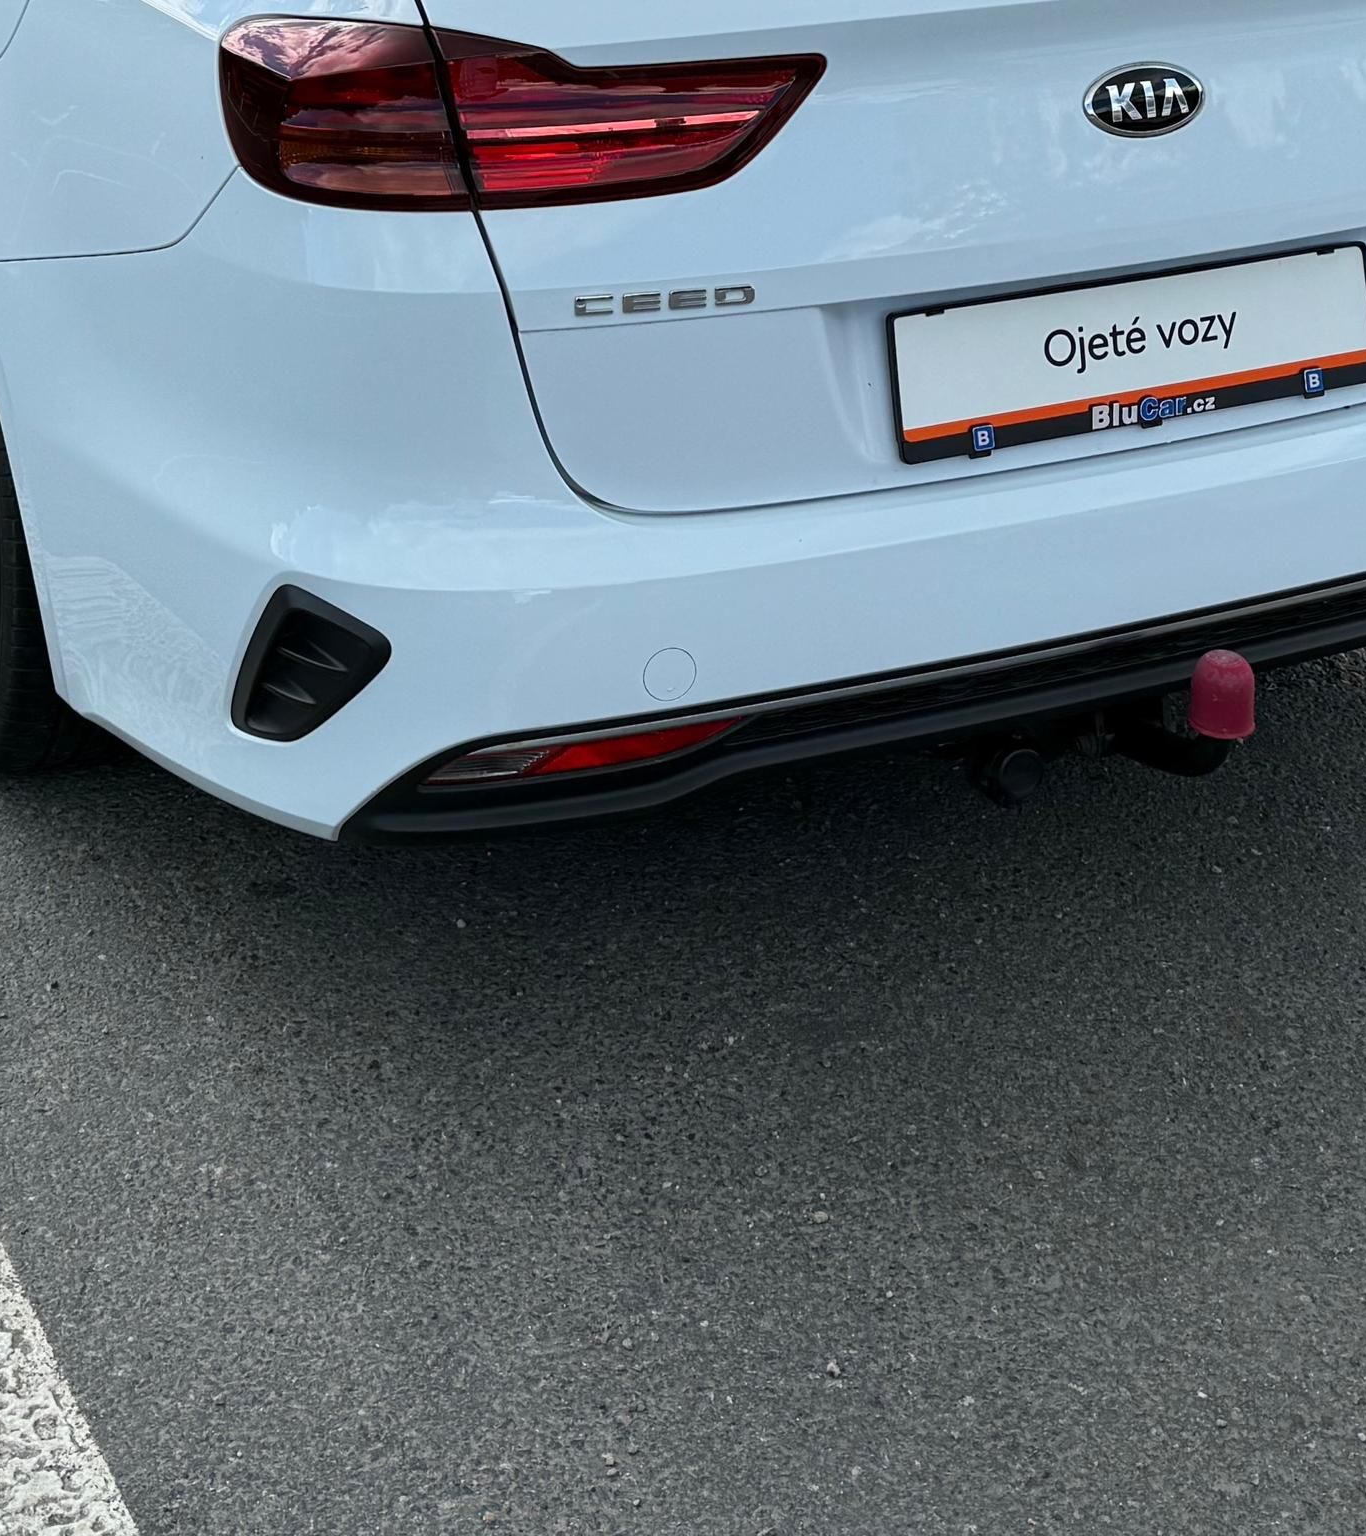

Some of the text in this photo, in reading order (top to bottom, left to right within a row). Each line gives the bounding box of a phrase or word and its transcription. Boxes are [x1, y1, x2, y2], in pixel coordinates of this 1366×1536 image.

[1105, 77, 1190, 123] KIA
[574, 285, 756, 316] CEED
[1043, 311, 1237, 374] Ojeté vozy
[1091, 394, 1216, 431] BluCar.cz
